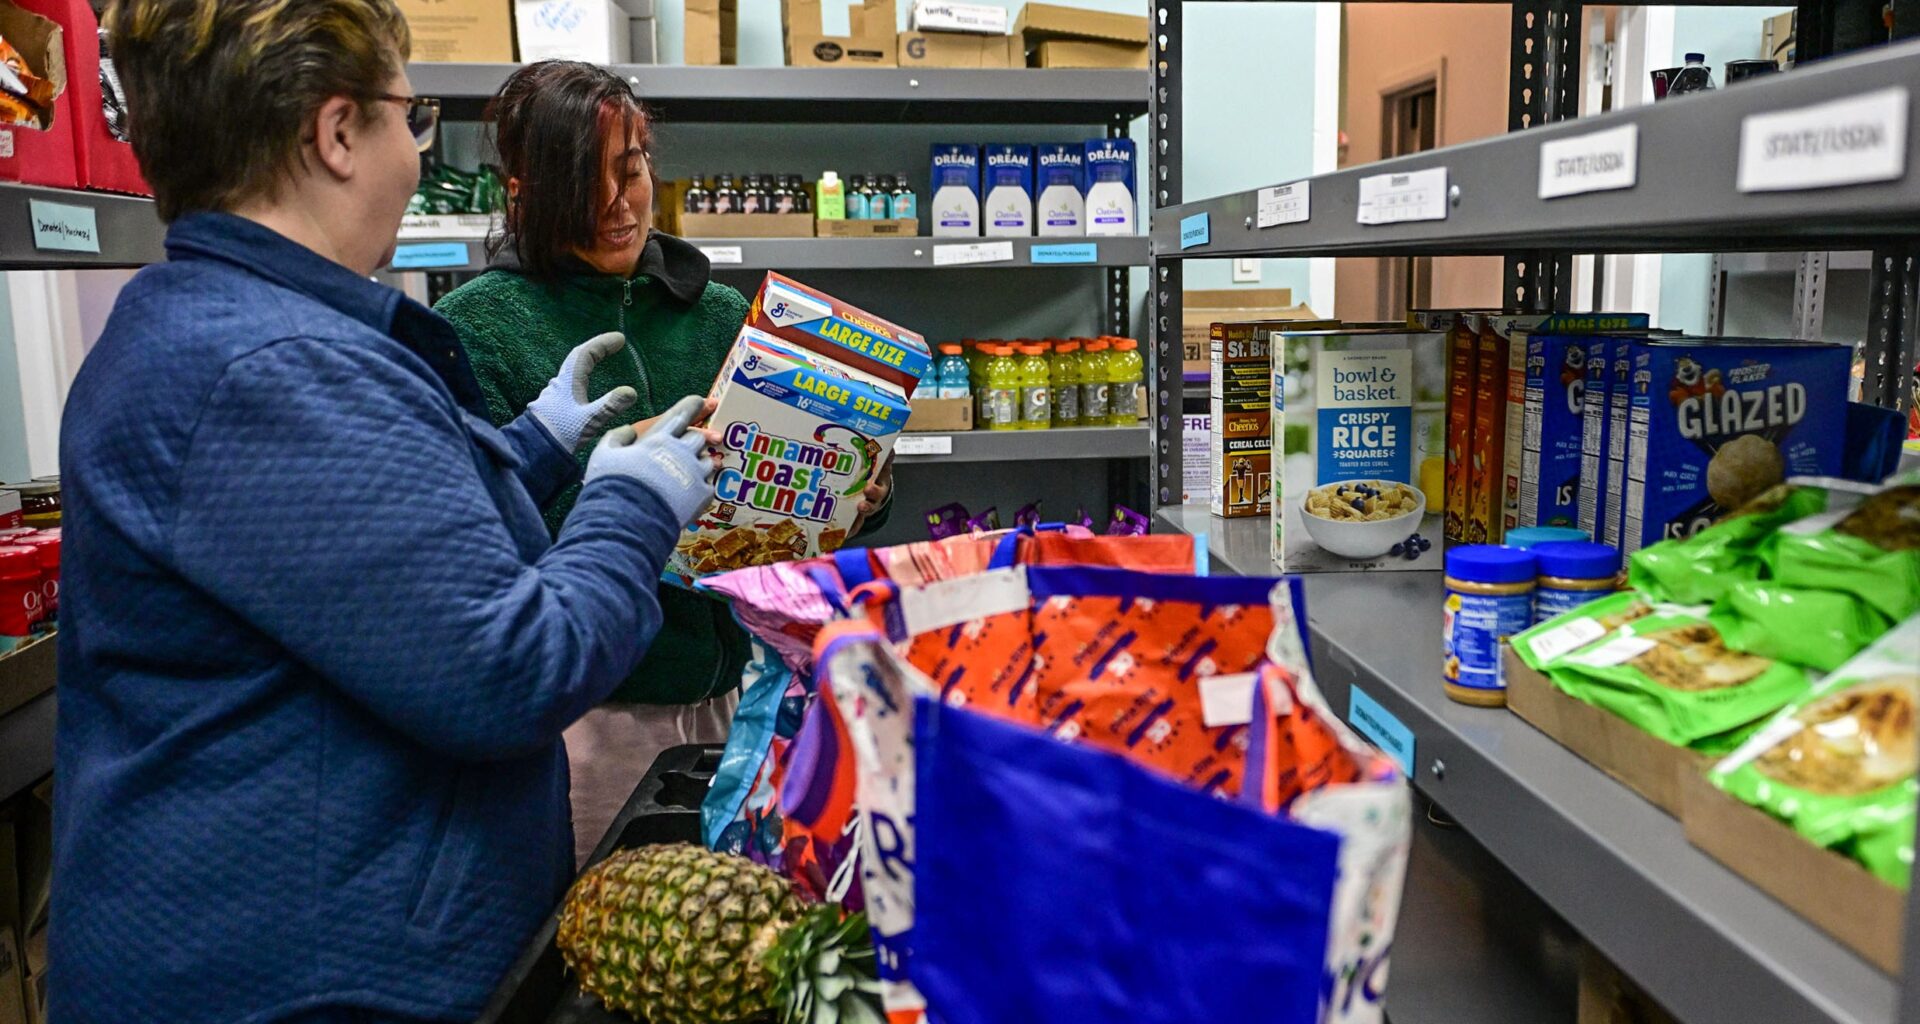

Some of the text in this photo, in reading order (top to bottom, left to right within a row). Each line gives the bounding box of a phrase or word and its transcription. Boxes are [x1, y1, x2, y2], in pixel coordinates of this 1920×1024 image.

[934, 153, 975, 166] DREAM
[988, 153, 1029, 166] DREAM
[1040, 153, 1081, 165] DREAM
[1087, 149, 1130, 162] DREAM
[842, 311, 892, 339] Cheerios
[819, 319, 907, 366] LARGE SIZE
[1228, 341, 1247, 358] St.
[1333, 366, 1396, 384] bowl &
[792, 372, 851, 406] LARGE
[853, 396, 892, 420] SIZE
[1333, 384, 1396, 402] basket
[1339, 413, 1390, 425] CRISPY
[1678, 382, 1808, 440] GLAZED
[1229, 422, 1259, 432] Cheerios
[1229, 441, 1253, 449] CEREAL
[1332, 426, 1397, 448] RICE
[728, 422, 854, 473] Cinnamon
[1339, 449, 1389, 459] SQUARES
[744, 452, 824, 493] Toast
[716, 467, 835, 521] Crunch
[1556, 485, 1573, 506] IS
